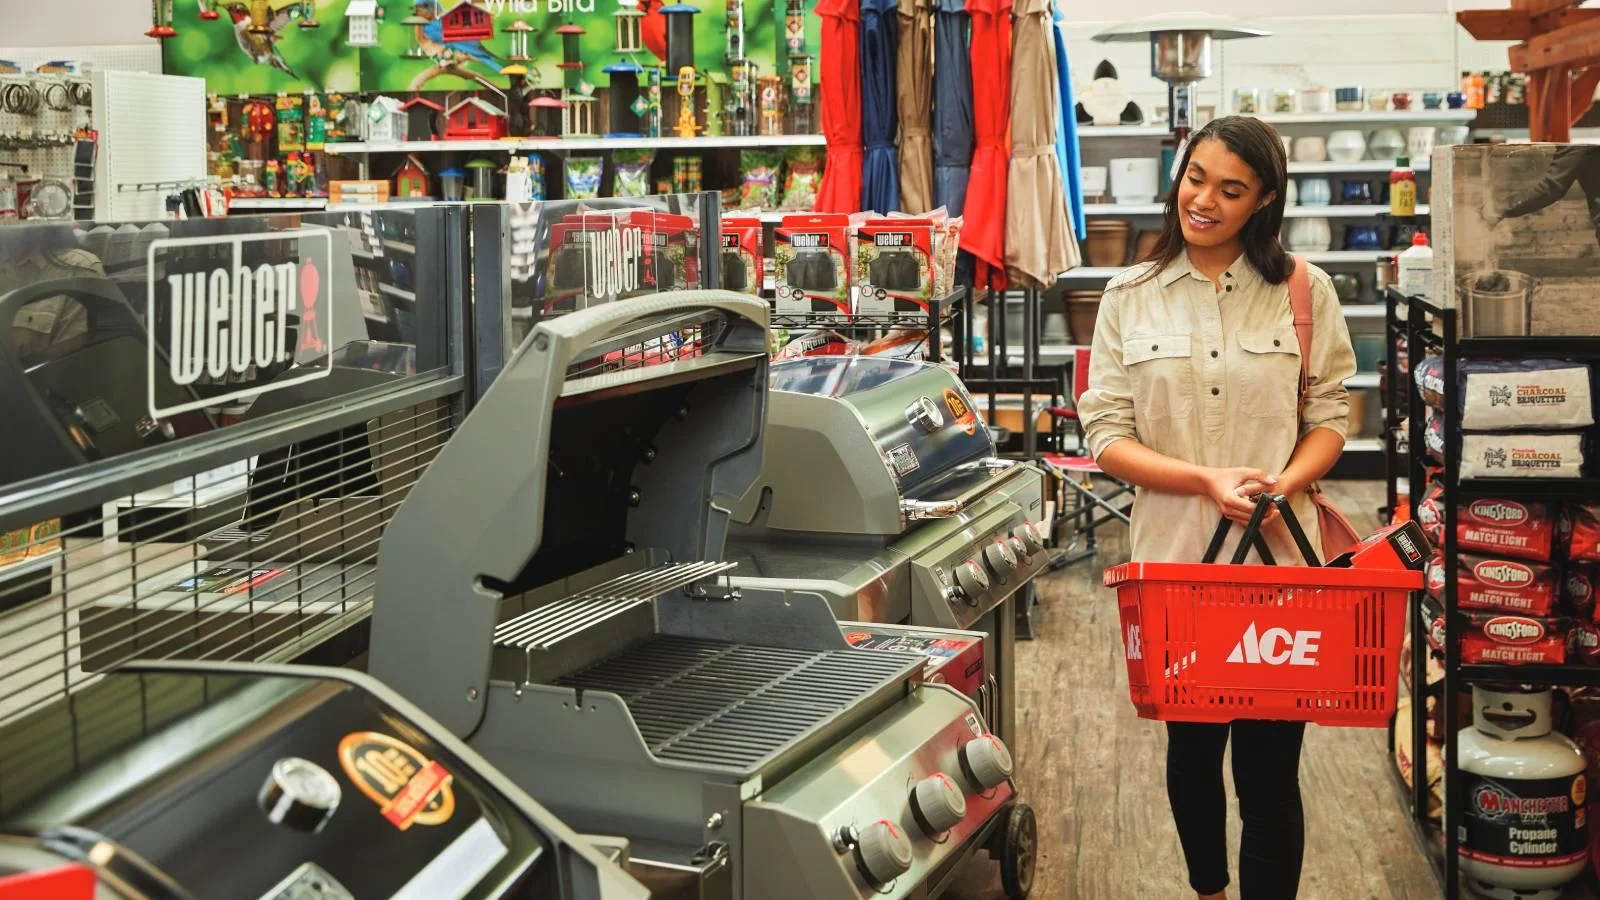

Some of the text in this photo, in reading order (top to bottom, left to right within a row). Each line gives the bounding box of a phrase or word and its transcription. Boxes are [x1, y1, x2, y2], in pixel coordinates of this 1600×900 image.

[548, 0, 595, 13] Bird
[794, 234, 820, 247] weber
[877, 232, 904, 246] weber
[590, 212, 642, 298] weber
[168, 240, 297, 385] weber
[1516, 388, 1566, 396] CHARCOAL
[1516, 396, 1566, 404] BRIQUETTES
[1511, 452, 1562, 460] CHARCOAL
[1511, 460, 1560, 468] BRIQUETTES
[1474, 503, 1523, 521] KINGSFORD
[1398, 533, 1415, 554] weber
[1465, 530, 1498, 544] MATCH
[1500, 534, 1529, 547] LIGHT
[1479, 565, 1529, 583] KINGSFORD
[1470, 591, 1503, 605] MATCH
[1505, 596, 1534, 609] LIGHT
[1490, 621, 1539, 639] KINGSFORD
[1127, 621, 1142, 660] ACE
[1226, 620, 1321, 665] ACE
[1482, 648, 1515, 660] MATCH
[1517, 651, 1546, 662] LIGHT
[1509, 828, 1557, 842] Propane
[1510, 842, 1558, 855] Cylinder
